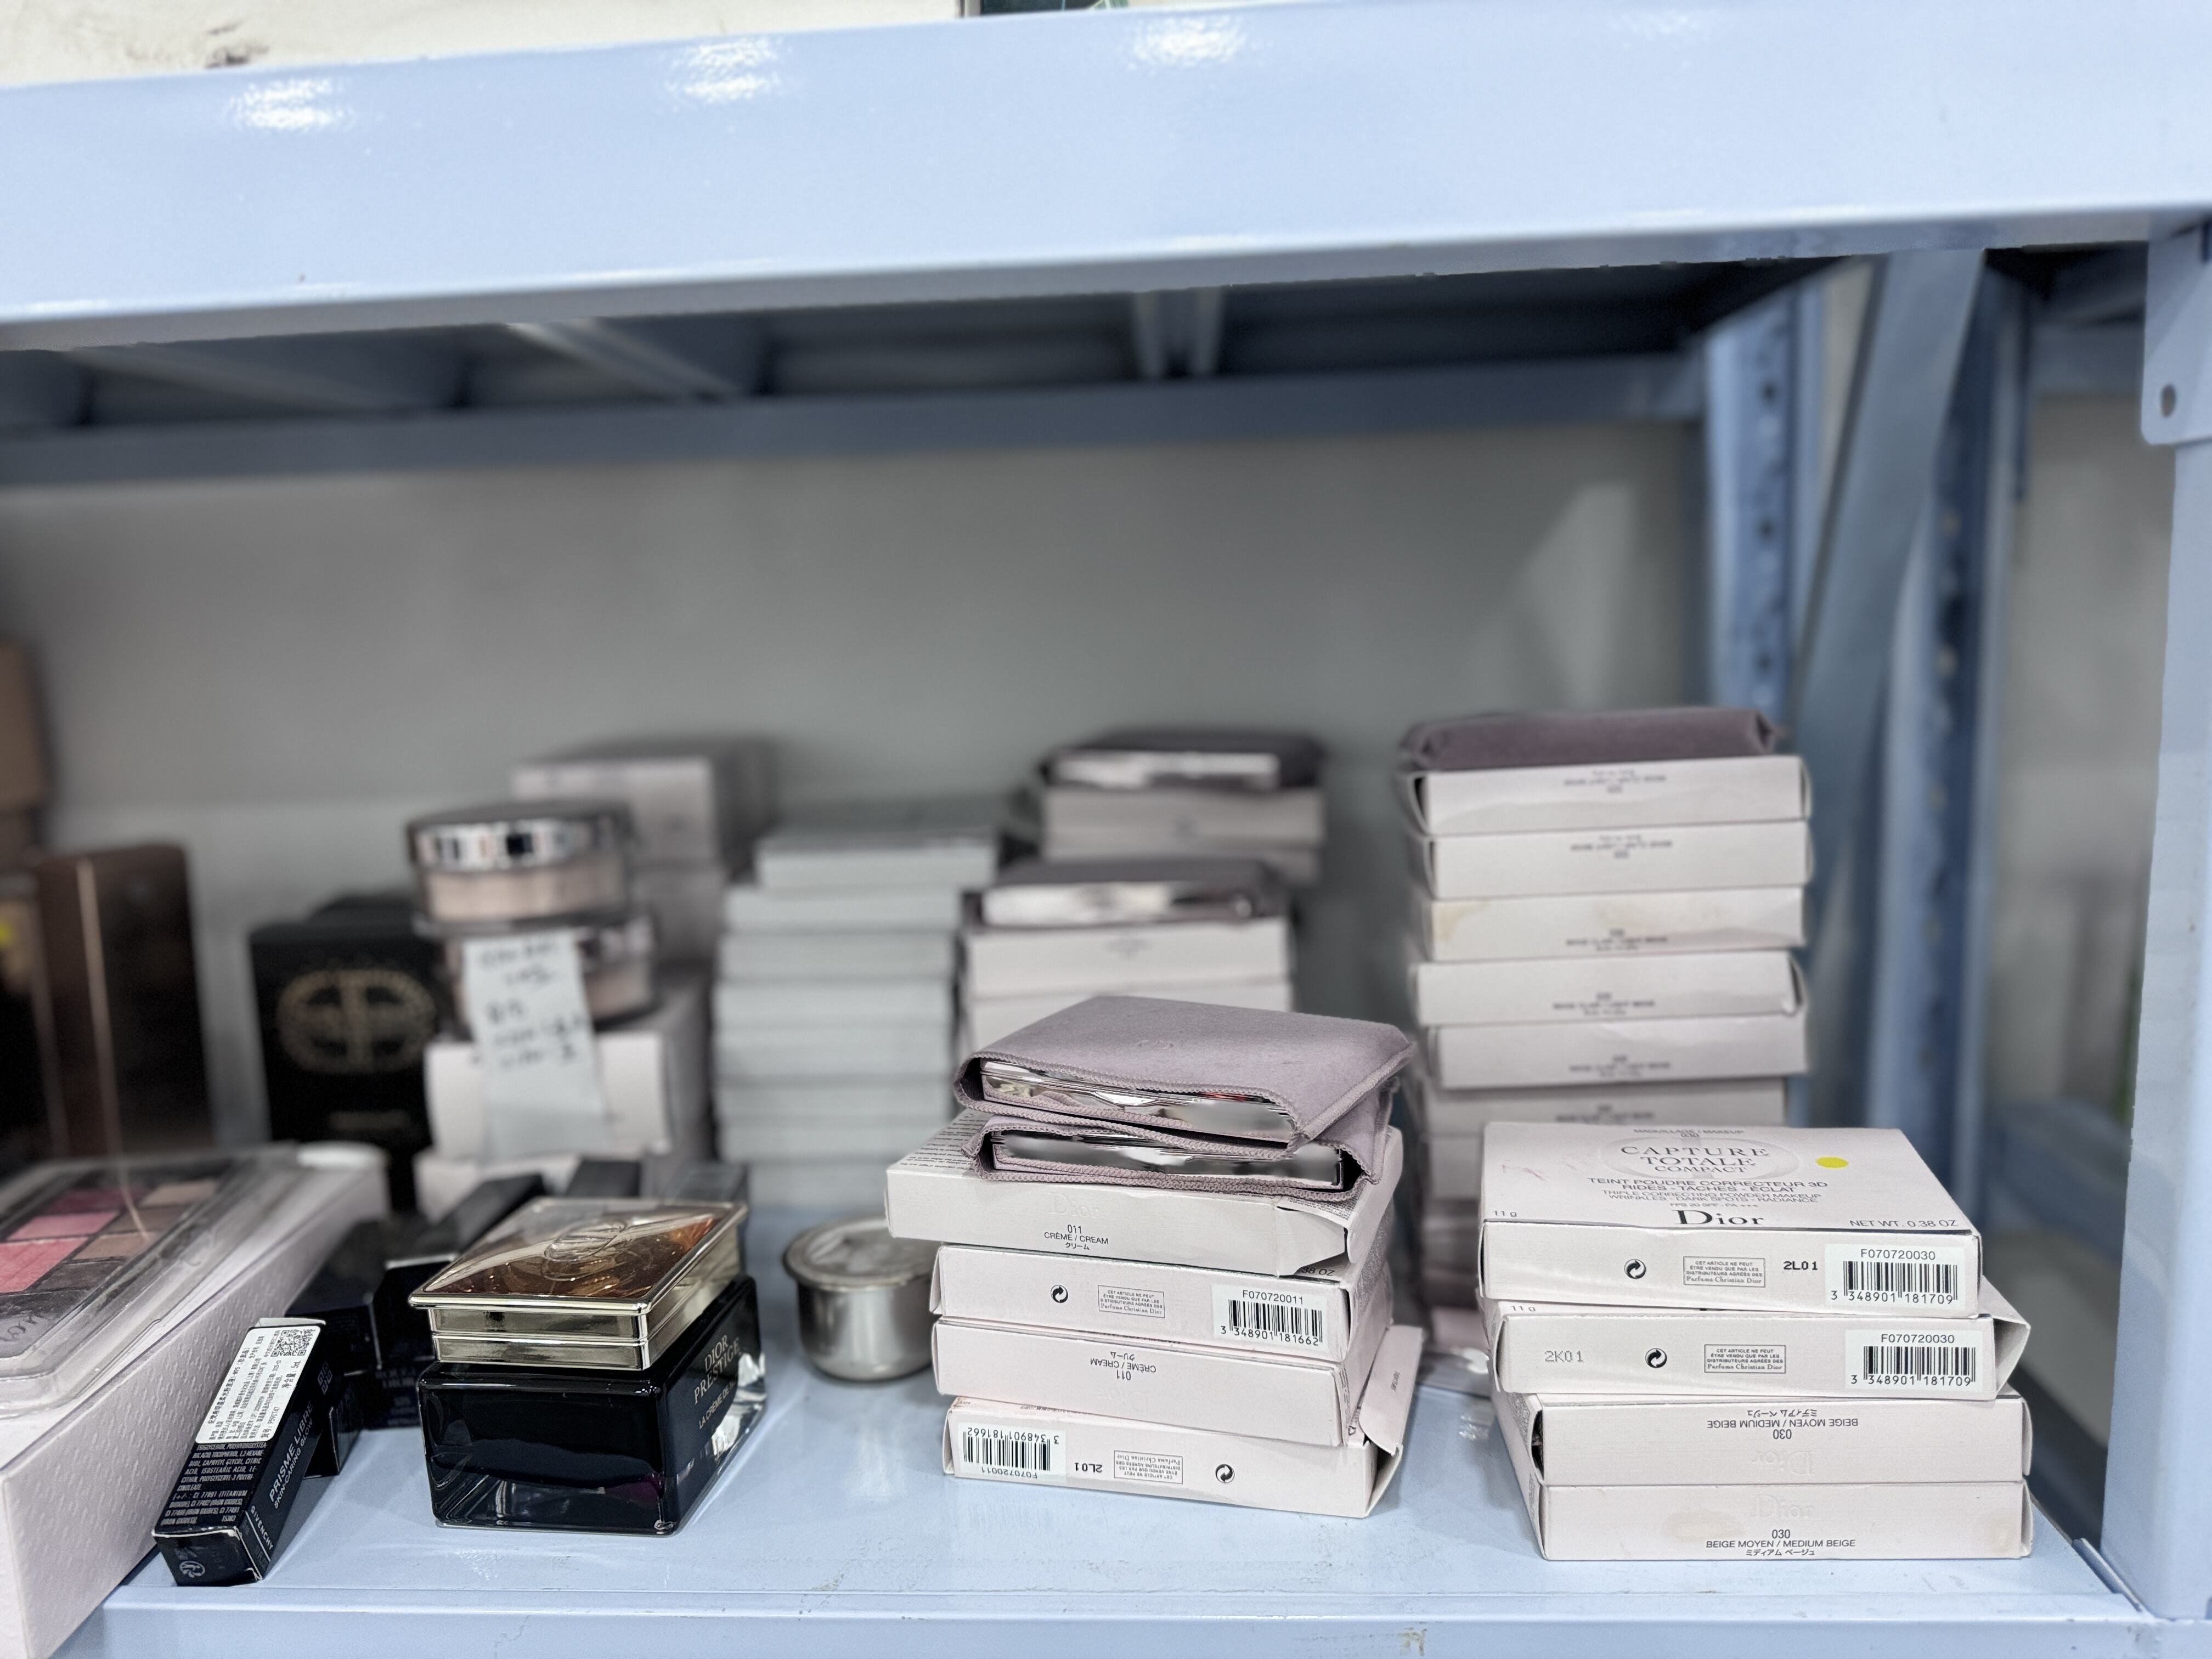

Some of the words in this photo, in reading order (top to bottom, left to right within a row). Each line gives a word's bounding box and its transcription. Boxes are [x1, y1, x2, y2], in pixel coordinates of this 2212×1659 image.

[1620, 1146, 1769, 1157] CAPTURE
[1640, 1156, 1756, 1166] TOTALE
[1671, 1209, 1764, 1225] Dior
[1068, 1224, 1082, 1234] 011
[1044, 1232, 1073, 1241] CRÈME
[1080, 1235, 1109, 1244] CREAM
[1861, 1249, 1936, 1260] F070720030
[1783, 1261, 1818, 1270] 2L01
[1243, 1290, 1303, 1305] F070720011
[1831, 1290, 1838, 1300] 3
[1848, 1290, 1895, 1302] 348901
[1905, 1294, 1953, 1305] 181709
[1124, 1305, 1148, 1313] Christian
[1221, 1325, 1227, 1334] 3
[1234, 1327, 1274, 1340] 348901
[1279, 1333, 1319, 1346] 181662
[1881, 1334, 1955, 1343] F070720030
[704, 1334, 729, 1373] DIOR
[1110, 1351, 1135, 1361] クリーム
[1544, 1350, 1584, 1362] 2K01
[1090, 1358, 1119, 1368] CREAM
[1127, 1362, 1156, 1373] CRÈME
[694, 1337, 741, 1405] PRESTIGE
[1116, 1370, 1131, 1380] 011
[1851, 1375, 1858, 1384] 3
[1868, 1375, 1915, 1385] 348901
[1923, 1376, 1971, 1386] 181709
[1780, 1409, 1818, 1418] ミディアム
[699, 1416, 706, 1430] LA
[1707, 1420, 1736, 1429] BEIGE
[1789, 1419, 1826, 1427] MOYEN
[1829, 1419, 1858, 1427] BEIGE
[967, 1427, 1003, 1440] 181662
[1009, 1431, 1046, 1443] 348901
[1773, 1429, 1792, 1439] 030
[1053, 1435, 1059, 1444] 3
[269, 1442, 295, 1502] PRISME
[294, 1401, 313, 1444] LIBRE
[274, 1447, 302, 1509] SKIN-CARING
[300, 1417, 313, 1447] GLOW
[1075, 1463, 1102, 1473] 2L01
[981, 1466, 1037, 1479] F070720011
[251, 1505, 274, 1550] GIVENCHY
[1771, 1529, 1791, 1539] 030
